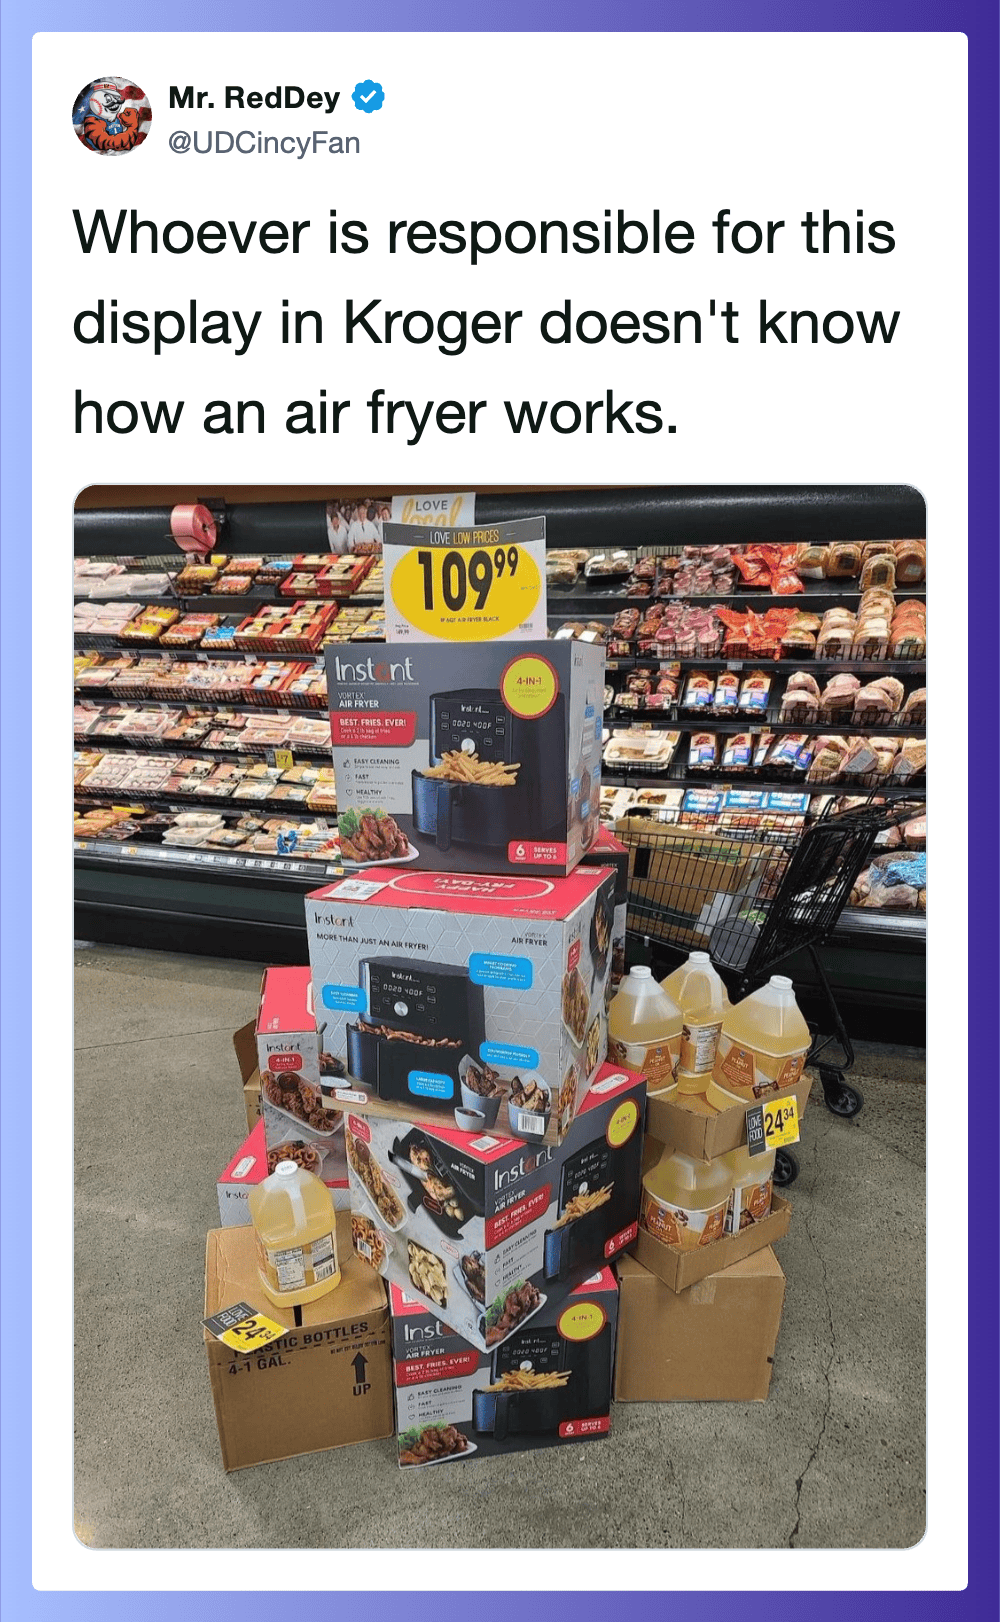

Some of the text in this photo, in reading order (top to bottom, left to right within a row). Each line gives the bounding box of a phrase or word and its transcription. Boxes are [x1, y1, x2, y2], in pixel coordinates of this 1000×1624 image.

[415, 500, 448, 512] LOVE
[429, 529, 499, 545] LOVE LOW PRICES
[335, 655, 414, 683] Instant
[516, 677, 542, 686] 4-IN-1
[337, 692, 365, 700] VORTEX
[339, 700, 379, 708] AIR FRYER
[339, 718, 407, 727] BEST. FRIES. EVER!
[516, 844, 557, 857] 6 SERVES
[314, 912, 354, 928] Instant
[316, 933, 429, 951] MORE THAN JUST AN AIR FRYER!
[525, 938, 548, 947] FRYER
[266, 1043, 301, 1053] Instant
[748, 1114, 762, 1130] LOVE
[749, 1127, 763, 1142] FOOD
[460, 1167, 476, 1181] FRYER
[494, 1145, 553, 1191] Instant
[226, 1190, 249, 1200] Insta
[494, 1189, 526, 1214] AIR FRYER
[528, 1193, 544, 1208] EVER!
[217, 1312, 238, 1327] FOOD
[229, 1306, 250, 1322] LOVE
[404, 1320, 457, 1341] Inst
[234, 1322, 369, 1357] ASTIC BOTTLES
[406, 1345, 431, 1353] VORTEX
[421, 1348, 445, 1358] FRYER
[229, 1357, 291, 1376] 4-1 GAL.
[449, 1356, 470, 1365] EVER!
[352, 1383, 372, 1396] UP
[418, 1409, 444, 1417] HEALTHY
[566, 1422, 574, 1432] 6
